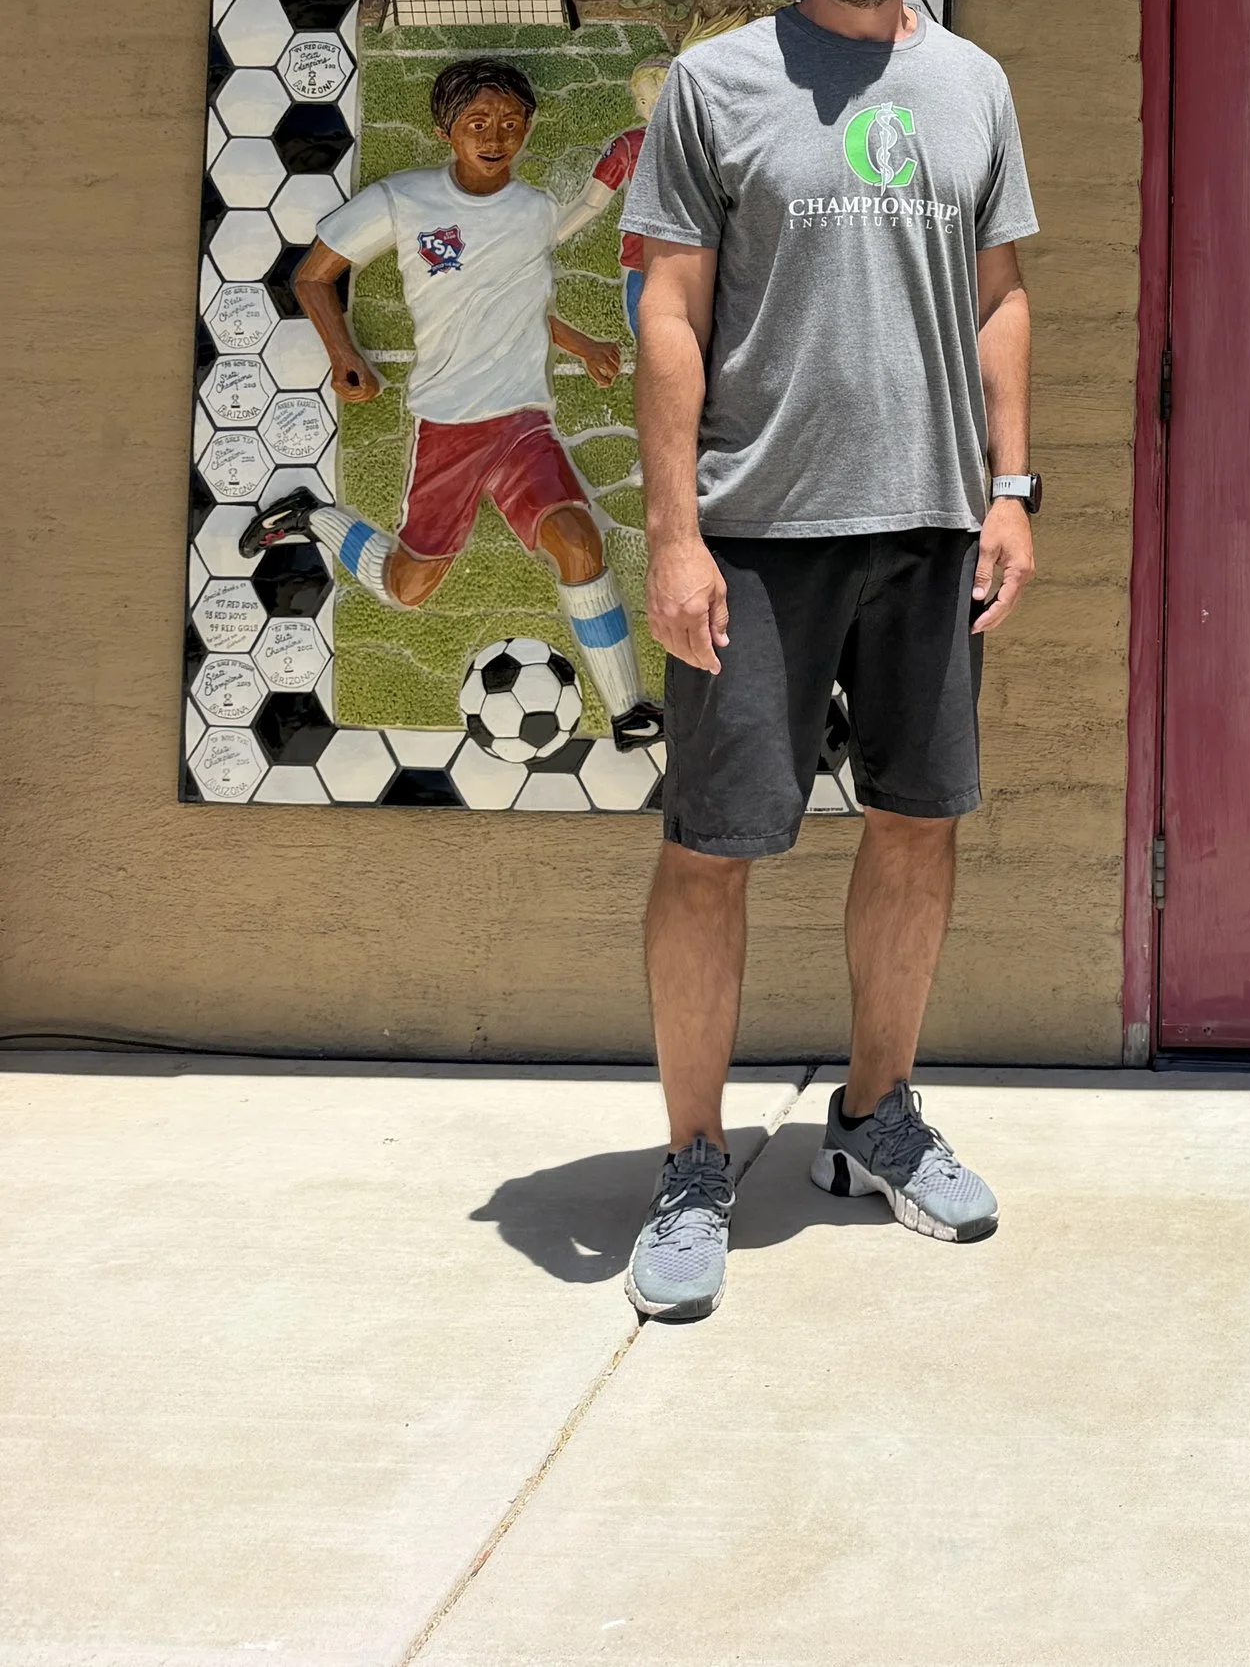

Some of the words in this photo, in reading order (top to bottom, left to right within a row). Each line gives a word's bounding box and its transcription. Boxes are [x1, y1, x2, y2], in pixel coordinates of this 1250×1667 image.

[293, 80, 335, 94] ARIZONA
[788, 196, 959, 222] CHAMPIONSHIP
[790, 215, 913, 229] INSTITUTE
[422, 236, 457, 258] TSA
[219, 330, 263, 347] ARIZONA
[217, 404, 262, 419] ARIZONA
[227, 600, 239, 608] RED
